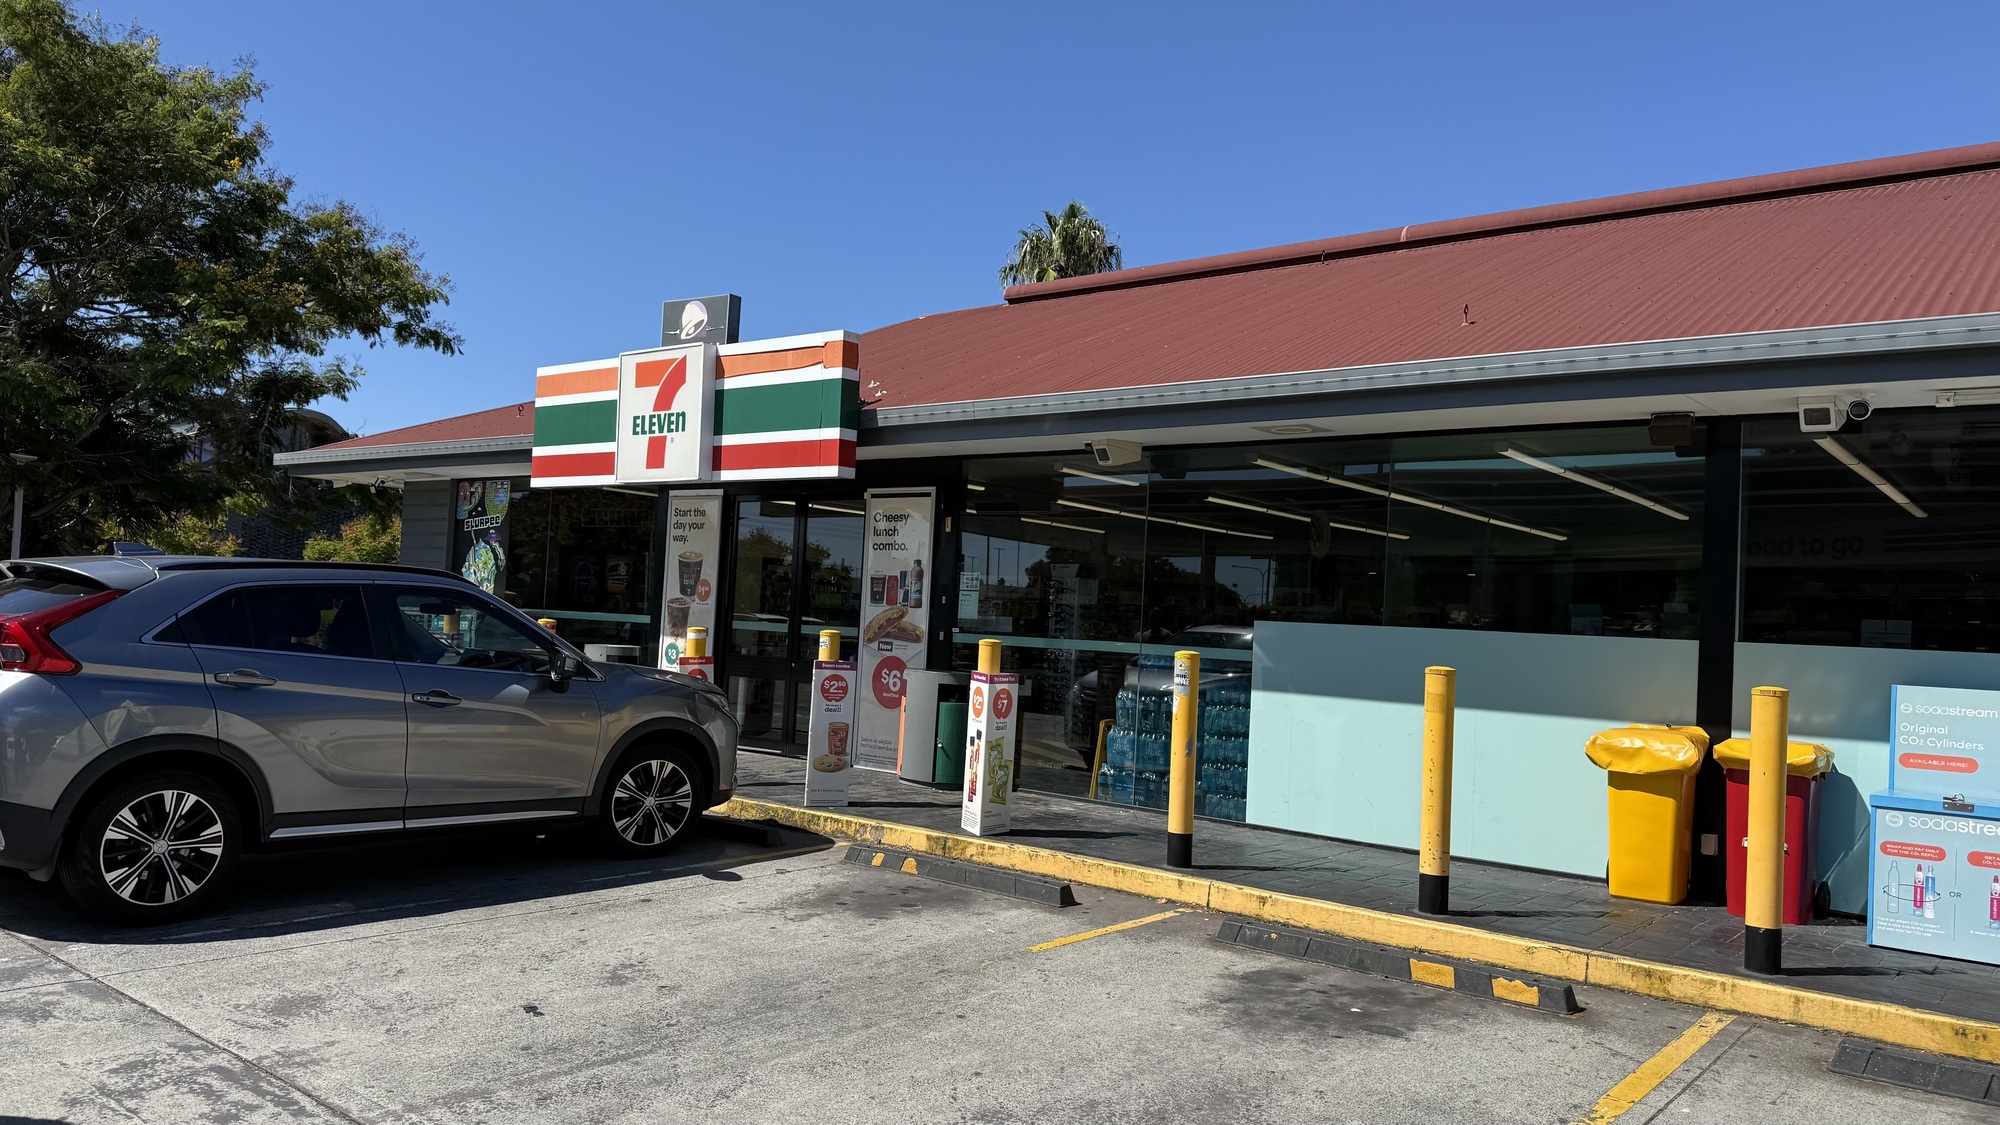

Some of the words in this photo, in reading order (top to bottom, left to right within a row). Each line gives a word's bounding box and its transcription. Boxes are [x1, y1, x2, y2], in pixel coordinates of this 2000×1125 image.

[635, 354, 687, 469] 7
[674, 507, 692, 518] Start
[693, 507, 706, 517] the
[873, 511, 910, 525] Cheesy
[464, 515, 501, 531] SLURPEE
[673, 520, 687, 532] day
[688, 522, 705, 532] your
[873, 526, 899, 537] lunch
[672, 534, 689, 544] way.
[872, 540, 908, 551] combo.
[1831, 536, 1864, 560] go
[667, 648, 677, 660] $3
[881, 668, 901, 692] $6
[997, 699, 1008, 713] $7
[1915, 705, 1998, 718] sodastream
[1900, 722, 1948, 735] Original
[1926, 737, 1984, 751] Cylinders
[1909, 758, 1945, 766] AVAILABLE
[1908, 816, 2000, 836] sodastre
